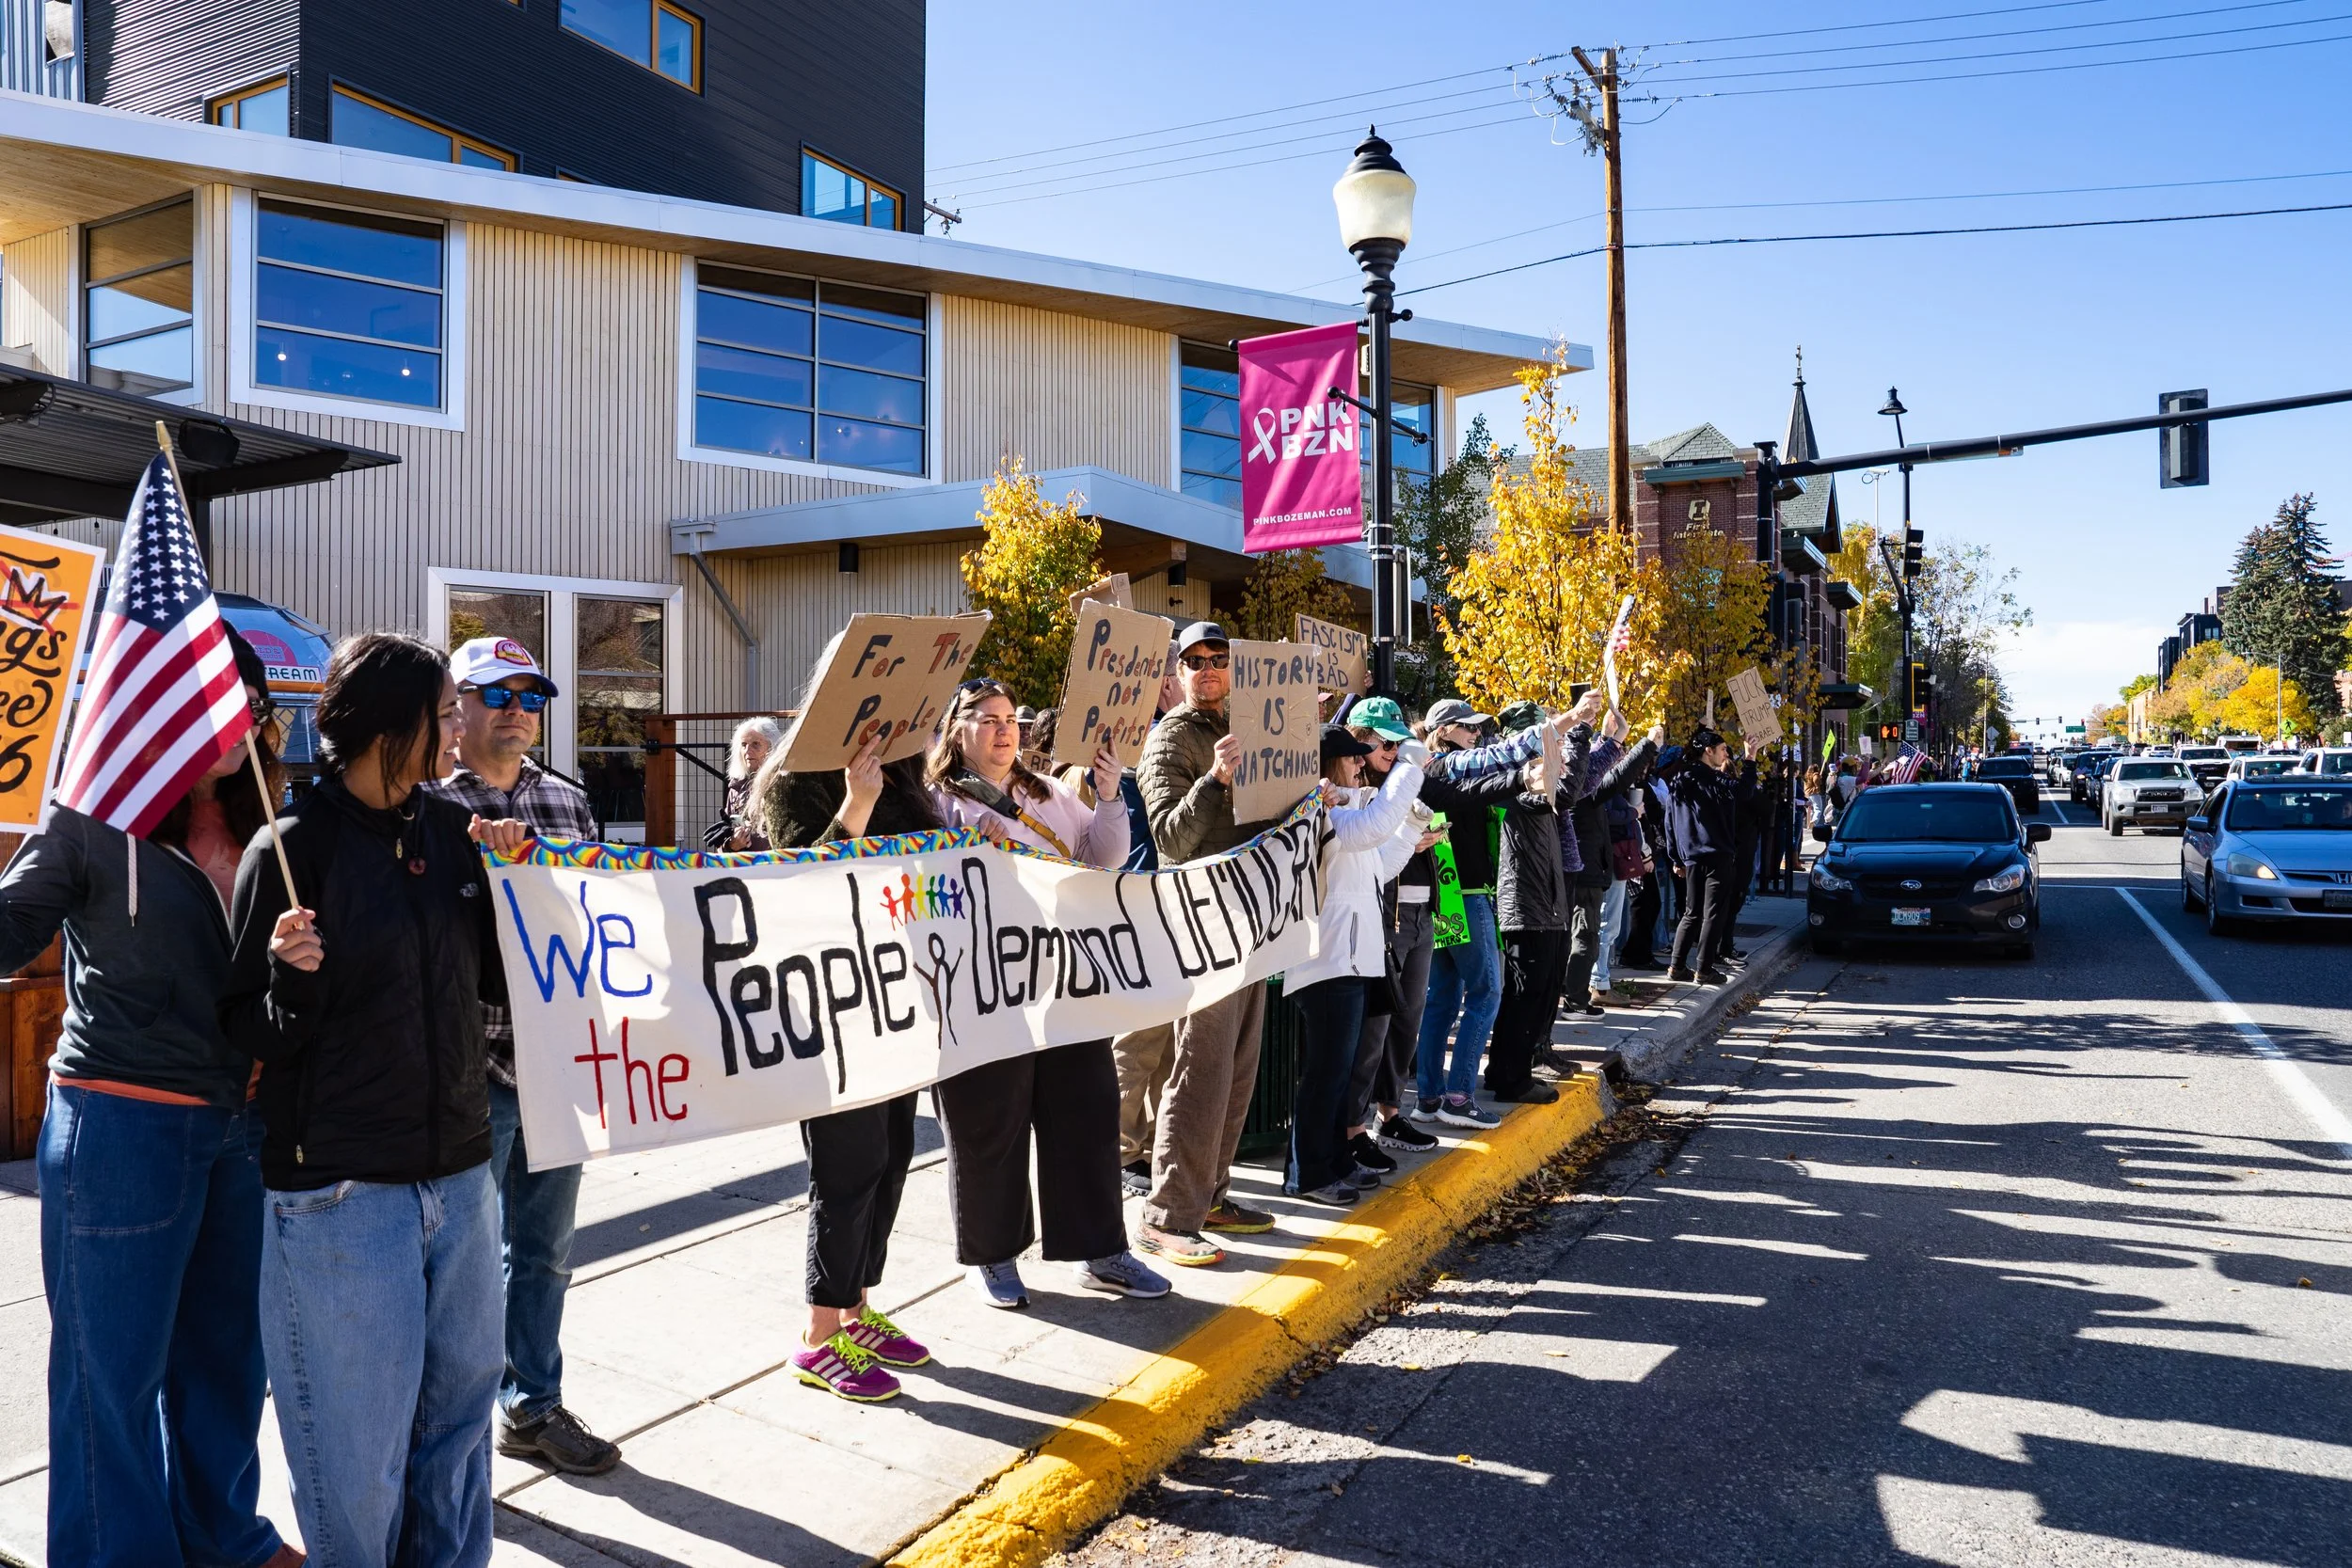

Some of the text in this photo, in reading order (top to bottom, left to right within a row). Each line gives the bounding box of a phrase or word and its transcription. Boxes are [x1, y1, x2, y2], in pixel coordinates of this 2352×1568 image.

[1280, 400, 1353, 434] PNK
[1281, 425, 1354, 461] BZN
[1253, 505, 1352, 526] PINKBOZEMAN.COM
[851, 632, 974, 679] For The
[1299, 616, 1364, 659] FASCISM
[265, 666, 318, 681] REAM
[1233, 654, 1314, 689] HISTORY
[1317, 662, 1349, 688] BAD
[1327, 652, 1339, 666] IS
[1106, 679, 1141, 706] not
[1727, 670, 1766, 706] FUCK
[843, 694, 936, 757] People
[1263, 696, 1285, 736] IS
[1740, 702, 1771, 725] TRUMP
[1754, 726, 1775, 743] SRAEL
[1233, 747, 1318, 787] WATCHING
[502, 878, 653, 1004] We
[693, 873, 915, 1095] People
[961, 857, 1152, 1016] Demand
[575, 1017, 690, 1130] the
